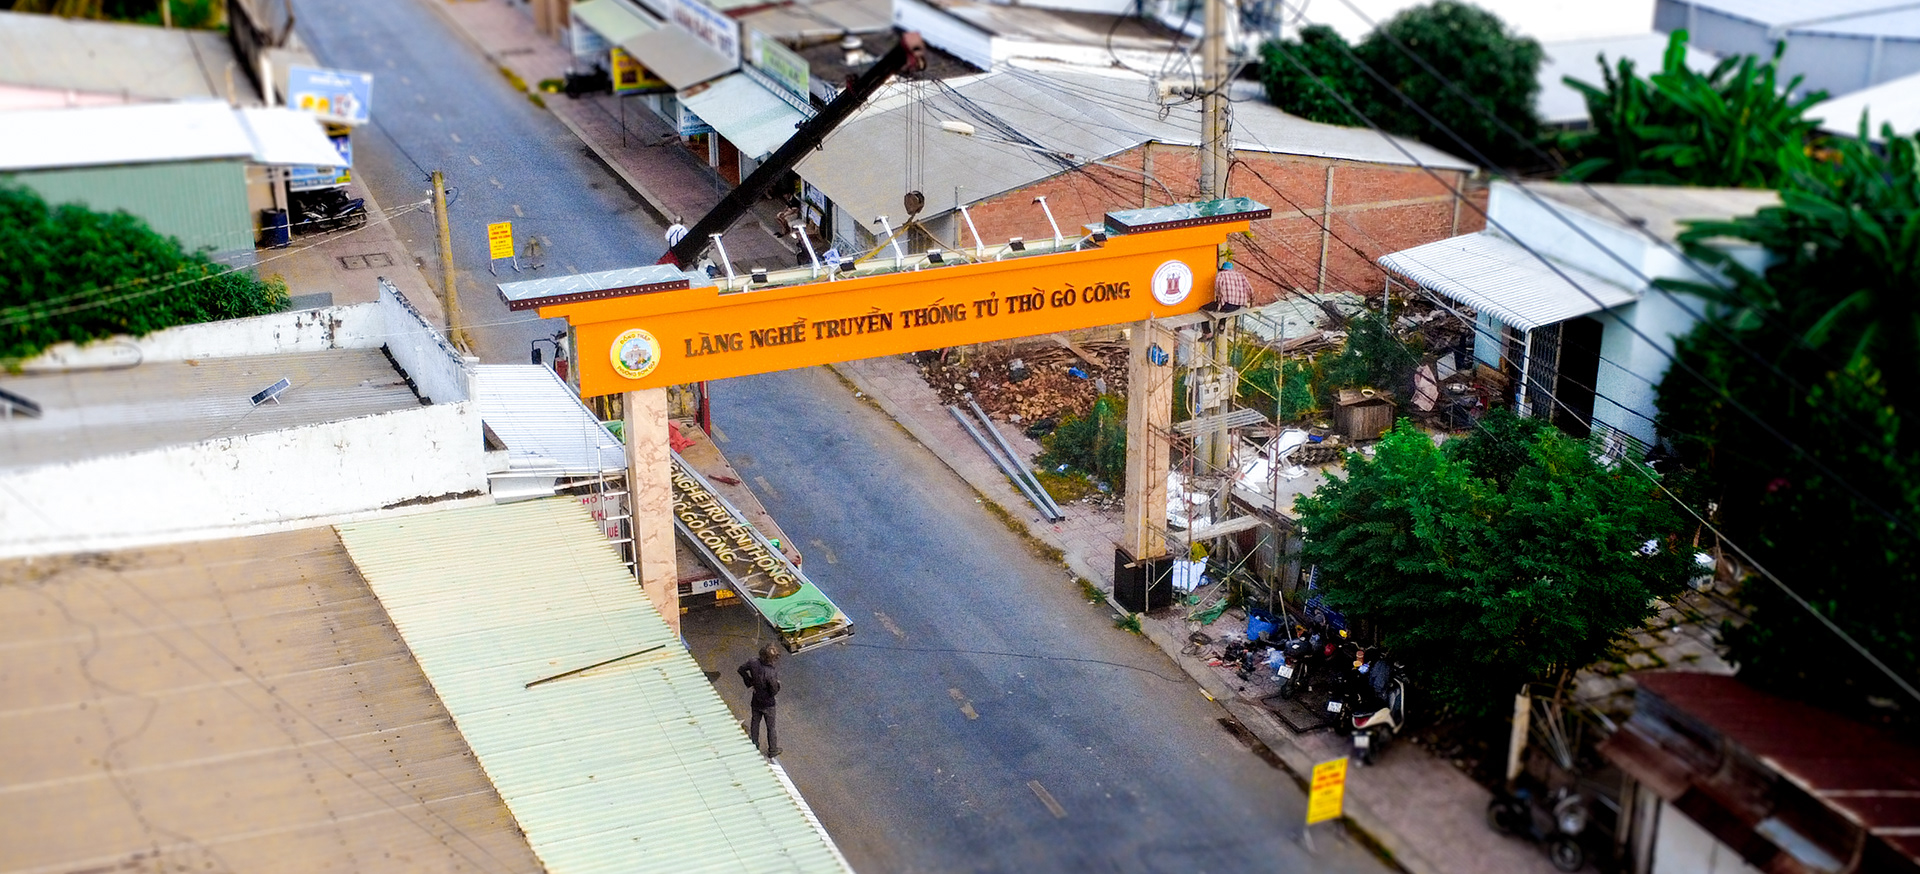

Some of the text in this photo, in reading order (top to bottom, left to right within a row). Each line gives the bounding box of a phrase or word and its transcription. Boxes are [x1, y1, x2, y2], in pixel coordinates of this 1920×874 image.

[684, 332, 743, 358] LÀNG
[750, 316, 807, 349] NGHỀ
[811, 306, 893, 340] TRUYỀN
[900, 297, 967, 329] THỐNG
[973, 291, 999, 319] TỦ
[1005, 287, 1045, 314] THỜ
[1050, 282, 1076, 308] GÒ
[1082, 281, 1131, 304] CÔNG
